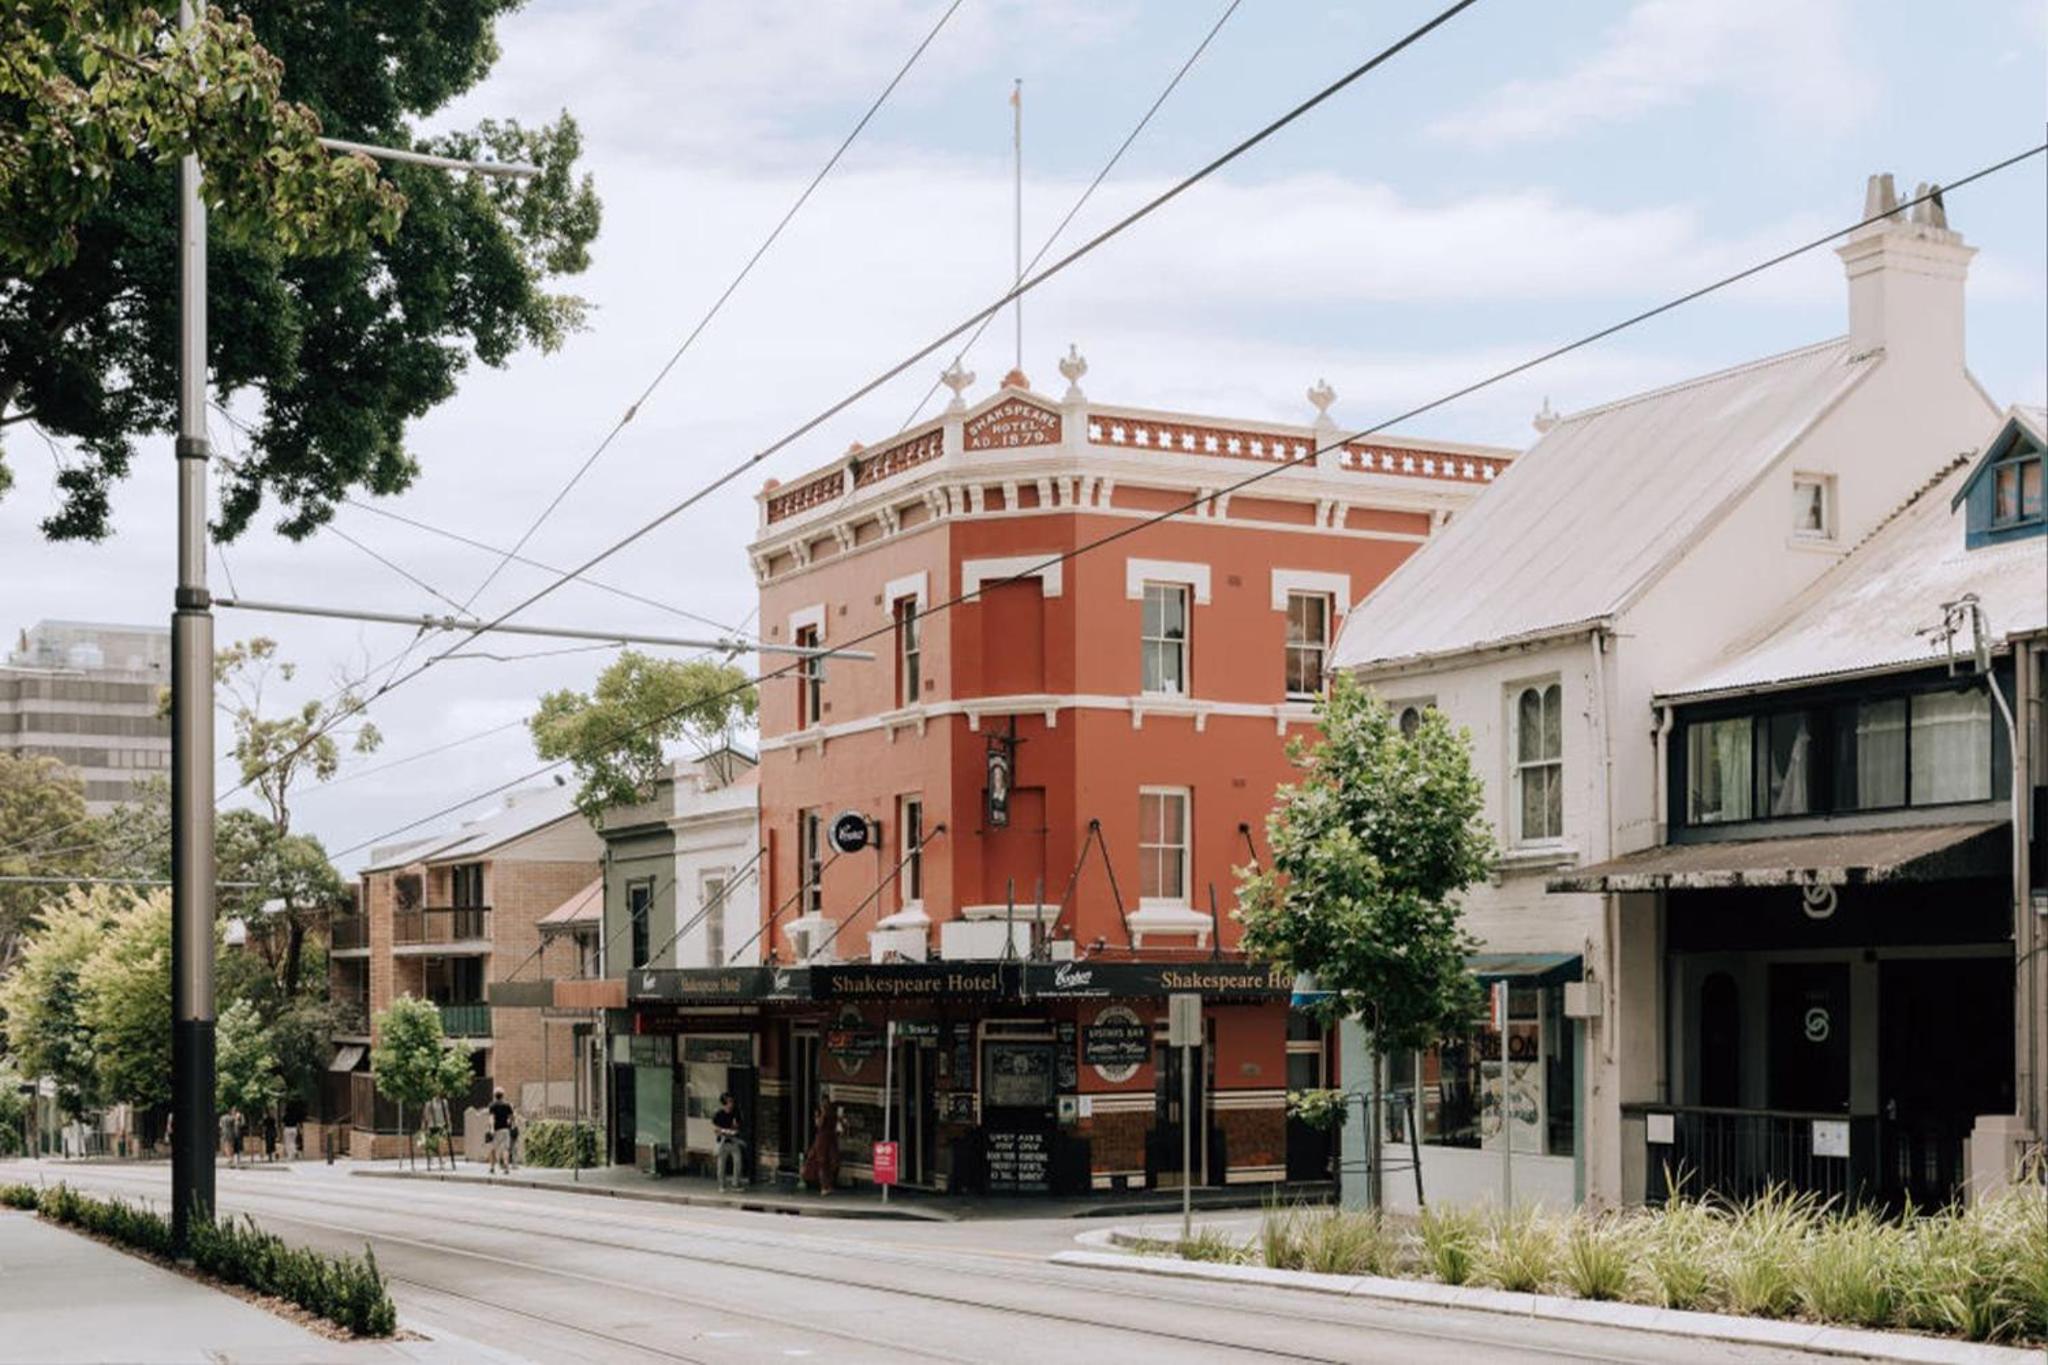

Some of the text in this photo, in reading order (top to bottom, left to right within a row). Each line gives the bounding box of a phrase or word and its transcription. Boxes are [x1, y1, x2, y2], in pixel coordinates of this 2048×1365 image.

[831, 973, 998, 996] Shakespeare Hotel
[1161, 971, 1263, 992] Shakespeare
